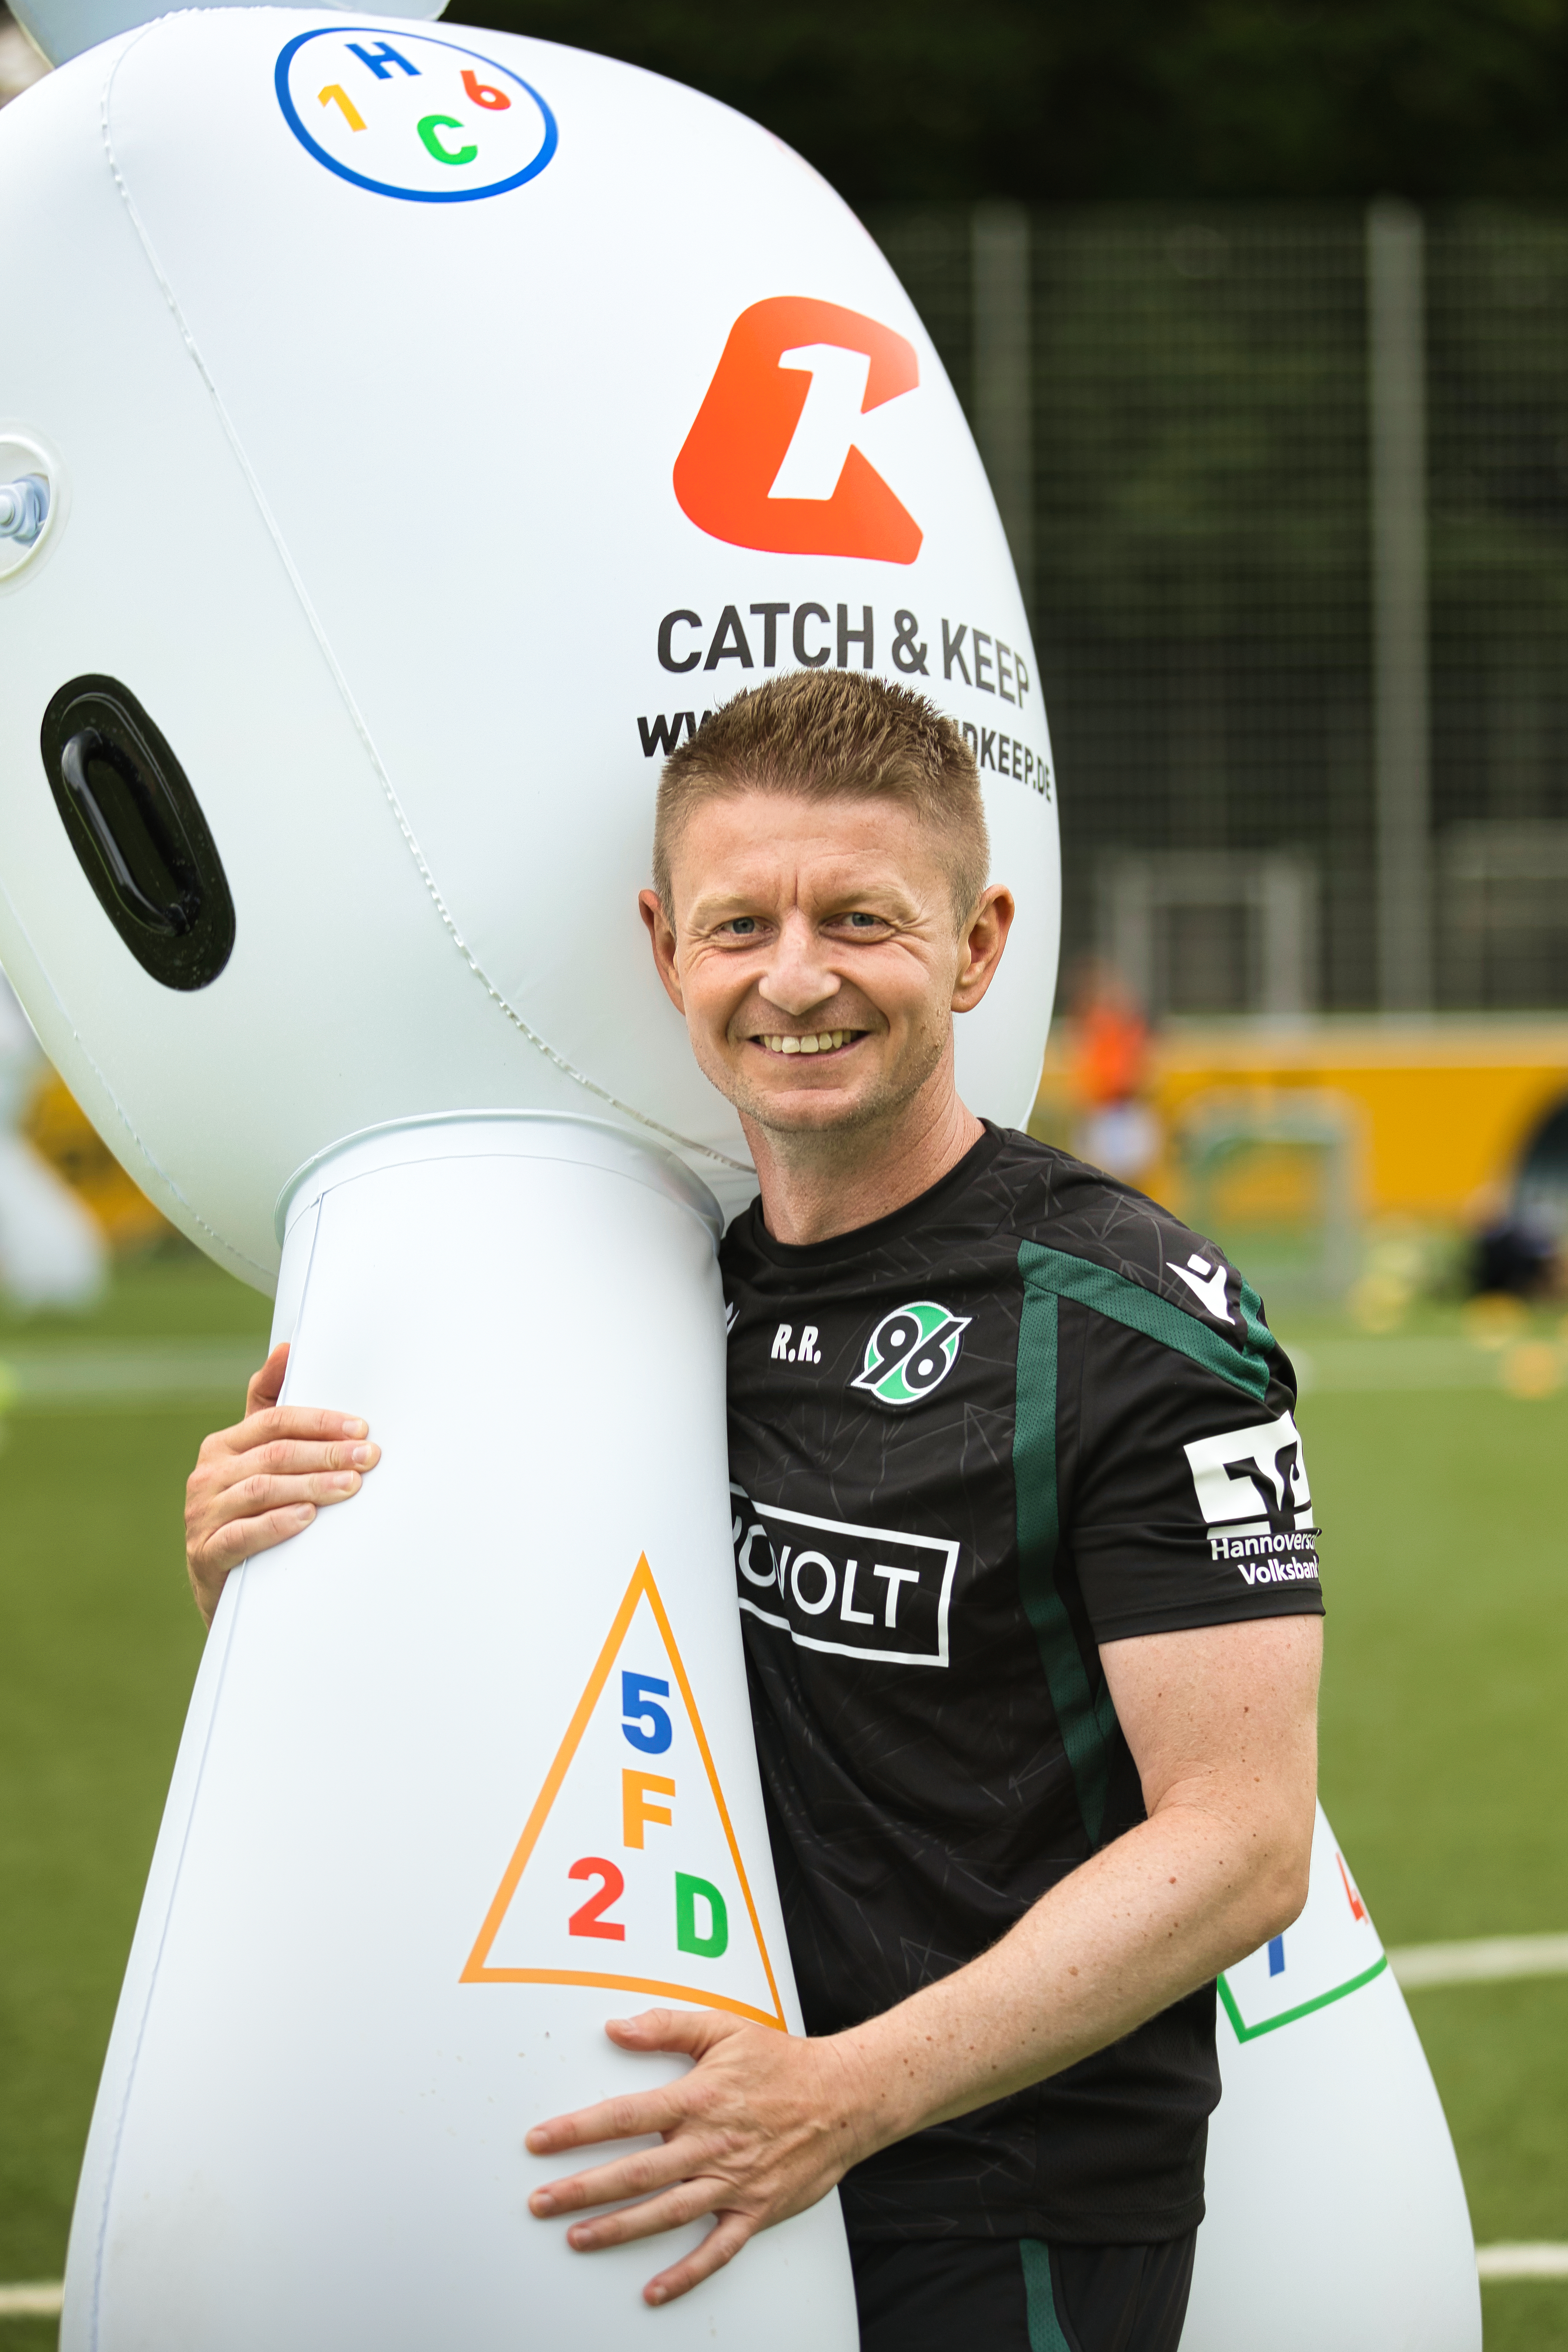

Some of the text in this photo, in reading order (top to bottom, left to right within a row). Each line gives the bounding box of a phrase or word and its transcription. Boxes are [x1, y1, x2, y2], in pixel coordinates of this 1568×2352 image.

[344, 41, 422, 79] H
[460, 69, 512, 111] 6
[318, 83, 368, 132] 1
[417, 114, 478, 165] C
[657, 602, 1030, 709] CATCH & KEEP
[771, 1323, 821, 1364] R.R.
[856, 1313, 969, 1391] 96
[732, 1515, 920, 1629] OVOLT
[1237, 1555, 1319, 1585] Volksbank
[621, 1670, 673, 1755] 5
[622, 1768, 676, 1850] F
[568, 1856, 626, 1942] 2
[675, 1870, 729, 1959] D
